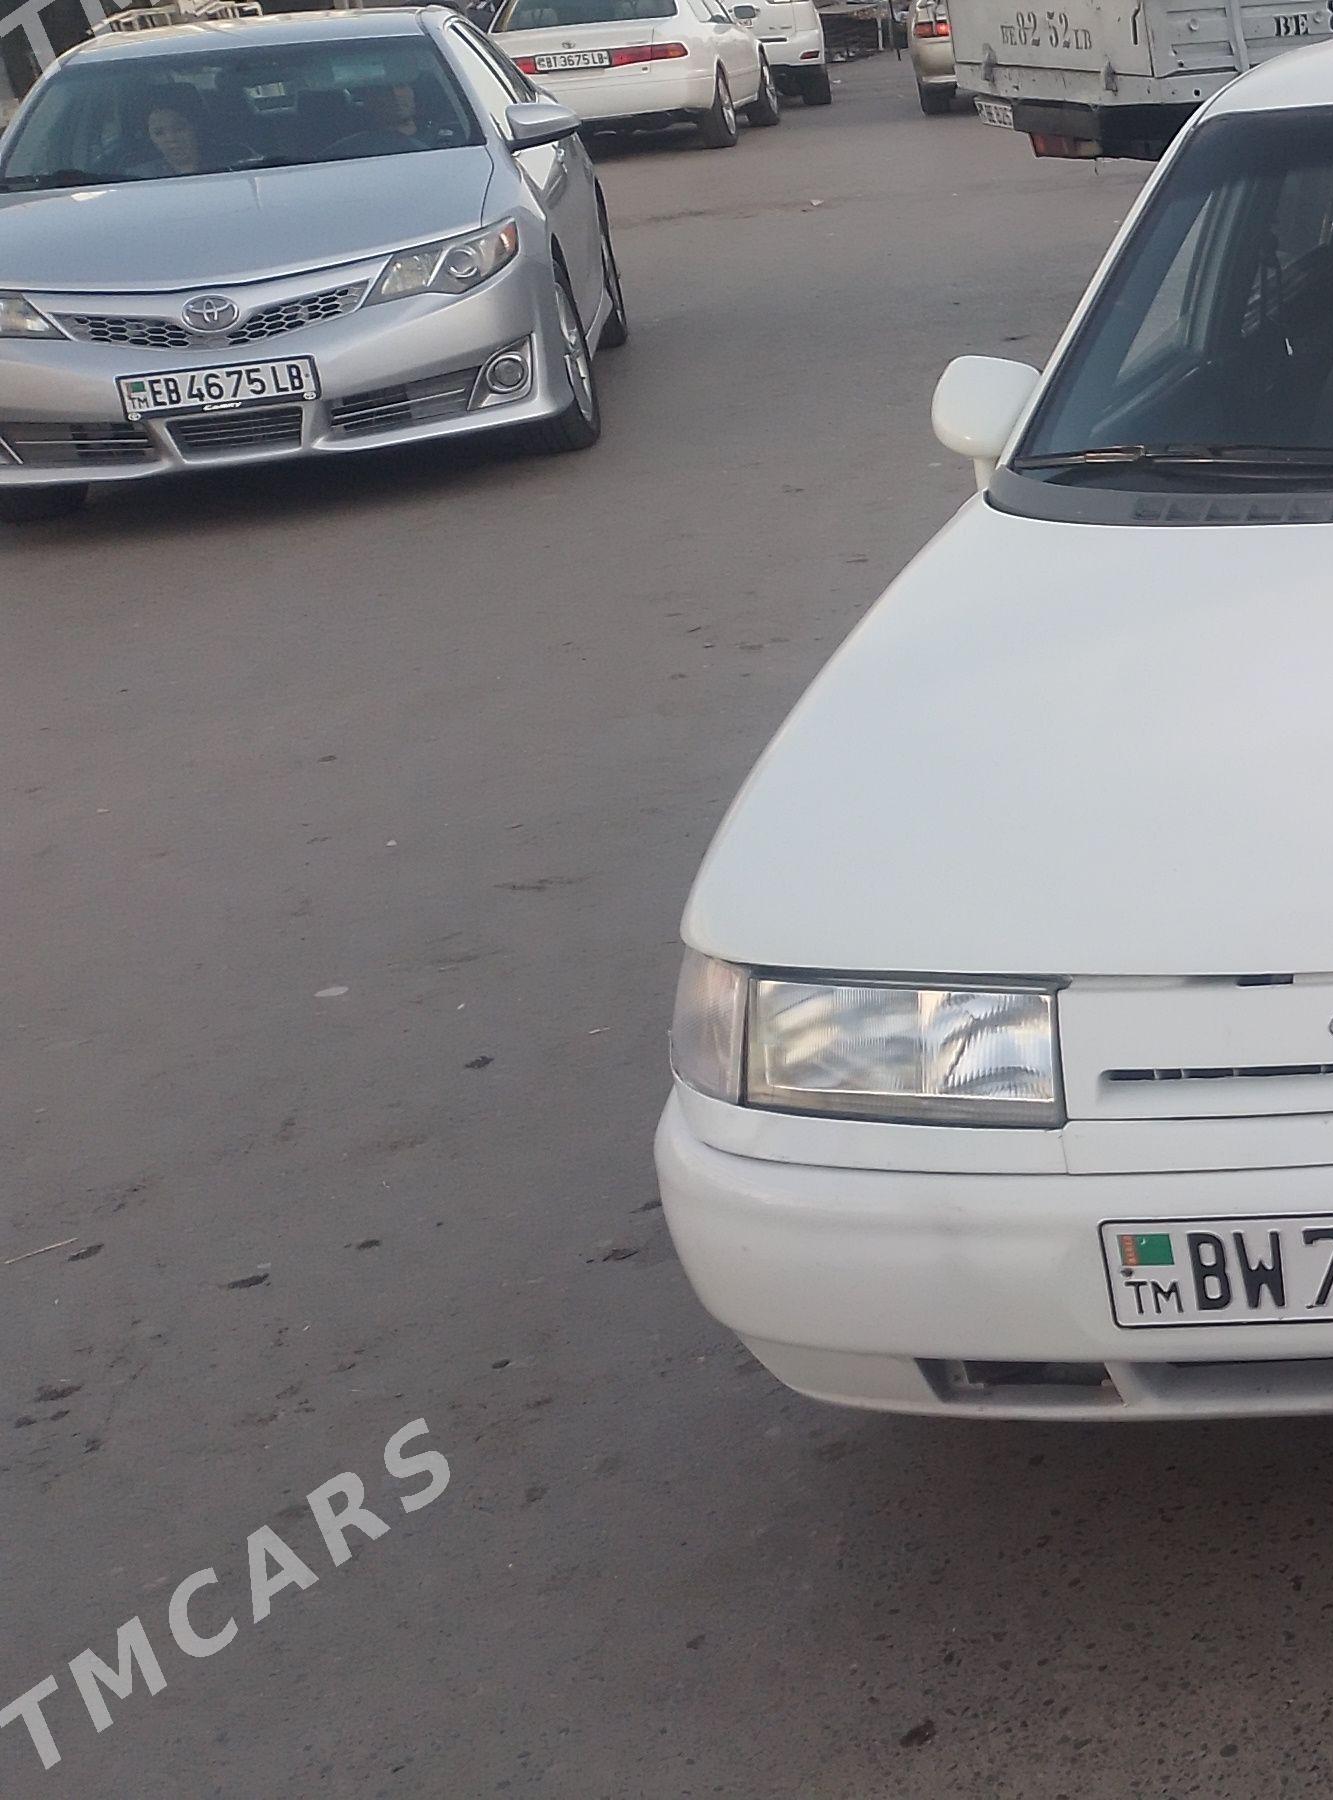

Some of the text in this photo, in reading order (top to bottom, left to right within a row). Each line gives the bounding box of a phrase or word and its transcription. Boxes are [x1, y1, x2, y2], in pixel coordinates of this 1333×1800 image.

[1016, 11, 1040, 47] 82
[1046, 11, 1071, 49] 52
[1073, 28, 1093, 50] LB
[1272, 14, 1308, 36] BE
[149, 378, 182, 406] EB
[186, 367, 267, 402] 4675
[271, 364, 304, 393] LB
[1124, 1281, 1184, 1314] TM
